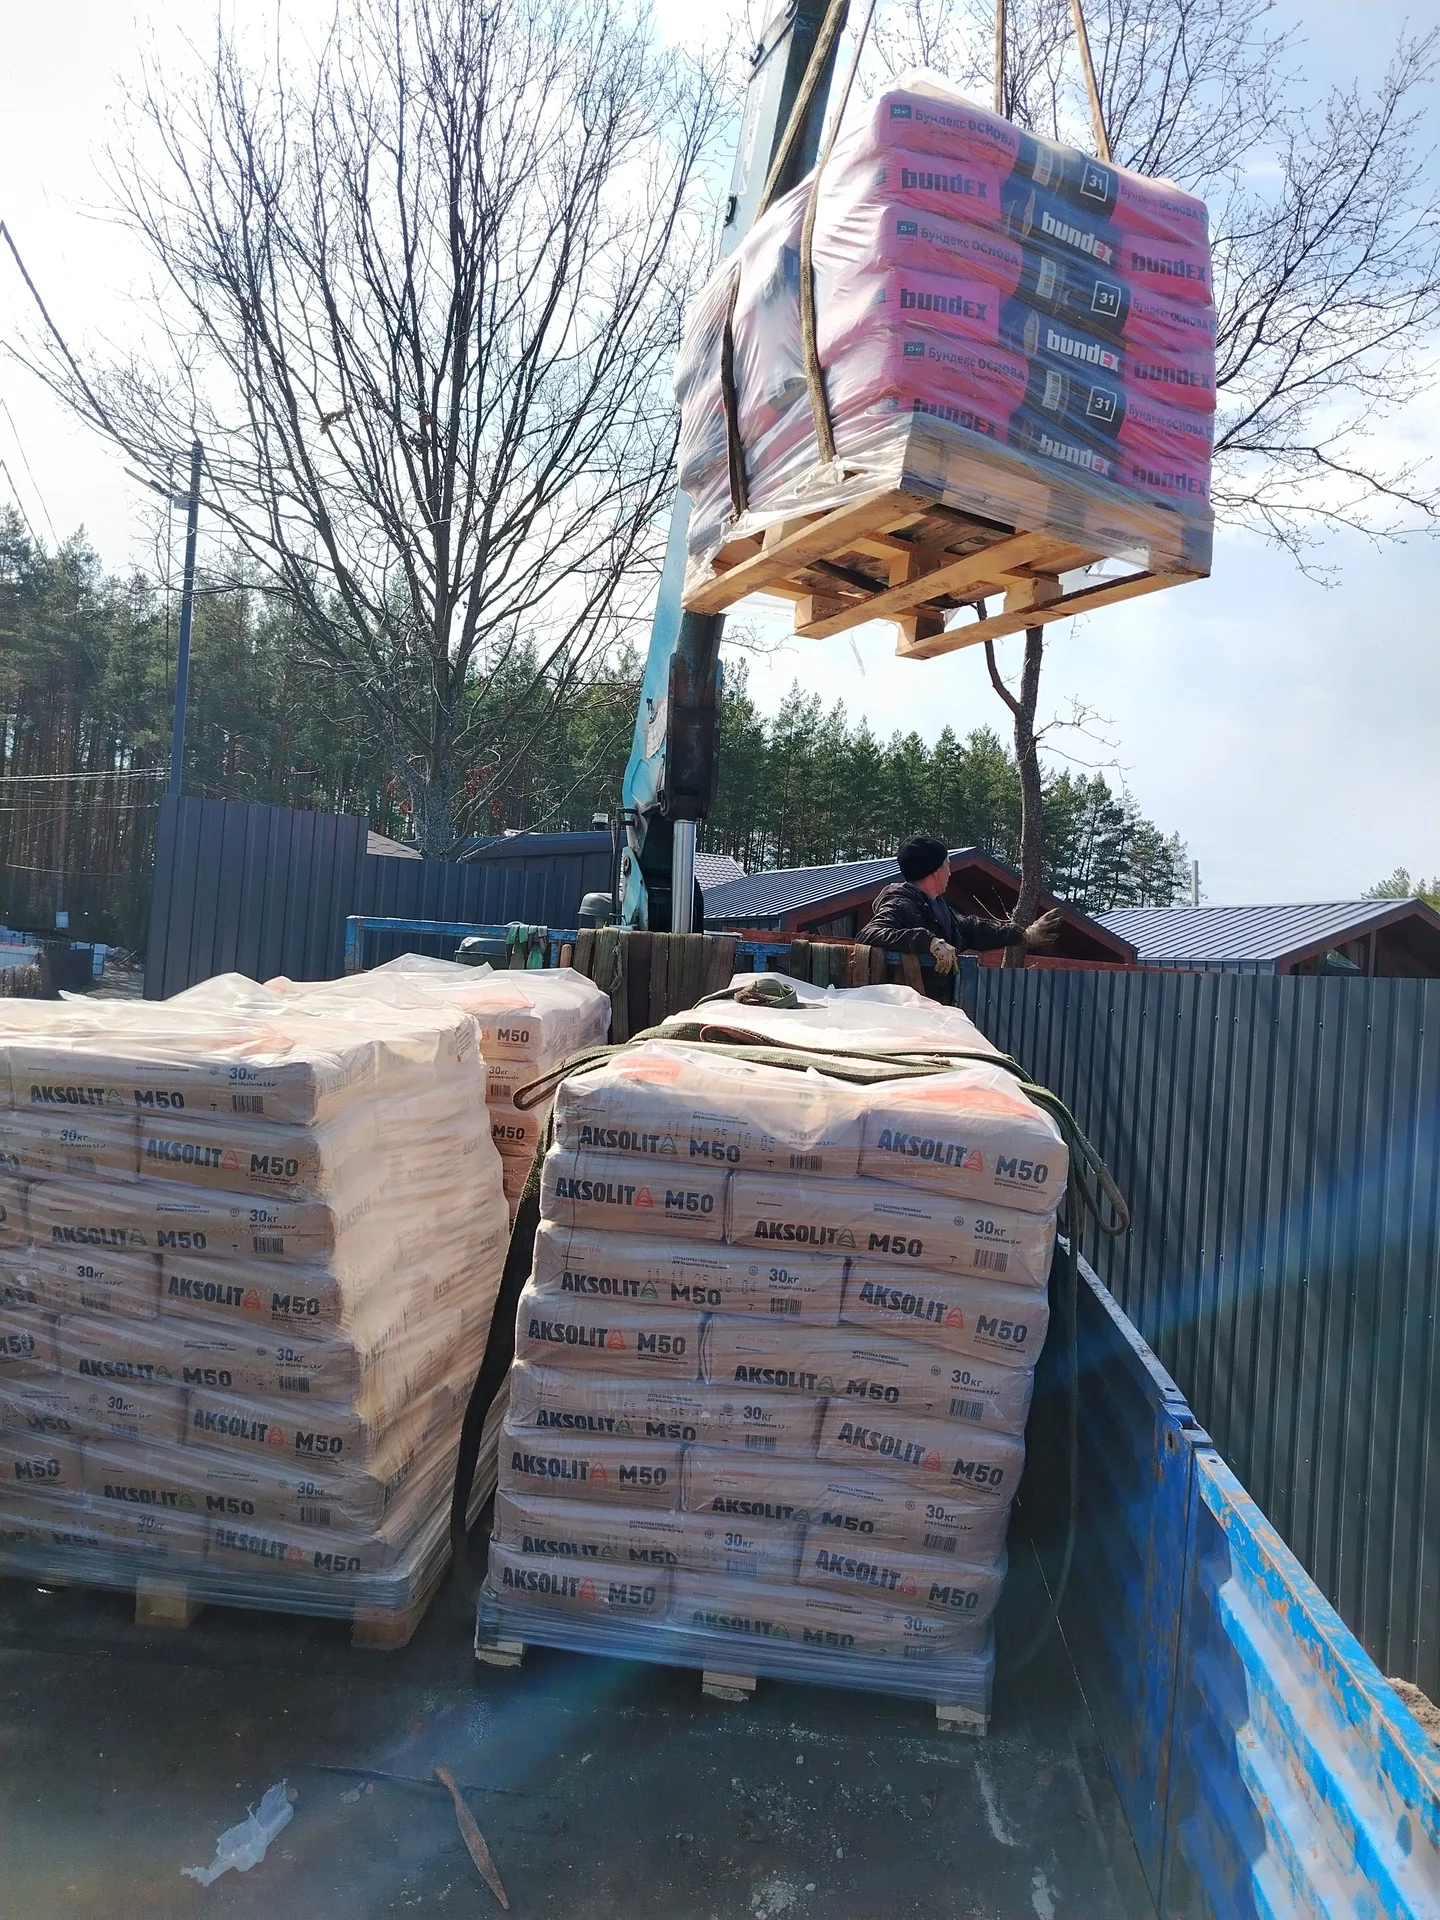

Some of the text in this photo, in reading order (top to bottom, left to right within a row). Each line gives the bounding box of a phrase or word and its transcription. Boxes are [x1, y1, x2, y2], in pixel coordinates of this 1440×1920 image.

[1089, 175, 1103, 190] 31
[1099, 292, 1115, 307] 31
[1095, 397, 1110, 412] 31
[497, 1028, 530, 1043] M50
[30, 1085, 185, 1109] AKSOLIT M50
[492, 1125, 525, 1140] M50
[580, 1126, 741, 1163] AKSOLIT M50
[146, 1139, 299, 1177] AKSOLIT M50
[877, 1129, 1049, 1184] AKSOLIT M50
[555, 1177, 714, 1213] AKSOLIT M50
[52, 1226, 207, 1250] AKSOLIT M50
[754, 1220, 923, 1257] AKSOLIT M50
[974, 1219, 1006, 1237] 30кг
[560, 1271, 722, 1306] AKSOLIT M50
[768, 1268, 800, 1284] 30кг
[168, 1276, 321, 1316] AKSOLIT M50
[858, 1281, 1028, 1343] AKSOLIT M50
[0, 1334, 36, 1355] 50
[528, 1319, 686, 1355] AKSOLIT M50
[79, 1358, 233, 1387] AKSOLIT M50
[734, 1365, 900, 1404] AKSOLIT M50
[951, 1369, 983, 1387] 30кг
[536, 1410, 697, 1441] AKSOLIT M50
[743, 1405, 774, 1421] 30кг
[194, 1408, 343, 1454] AKSOLIT M50
[511, 1452, 667, 1486] AKSOLIT M50
[837, 1421, 1004, 1486] AKSOLIT M50
[104, 1484, 255, 1515] AKSOLIT M50
[925, 1504, 956, 1522] 30кг
[711, 1497, 875, 1534] AKSOLIT M50
[215, 1527, 361, 1572] AKSOLIT M50
[522, 1536, 599, 1556] AKSOLIT
[628, 1548, 679, 1564] M50
[724, 1532, 754, 1548] 30кг
[502, 1566, 656, 1605] AKSOLIT M50
[815, 1549, 979, 1609] AKSOLIT M50
[692, 1611, 855, 1646] AKSOLIT M50
[903, 1615, 933, 1633] 30кг
